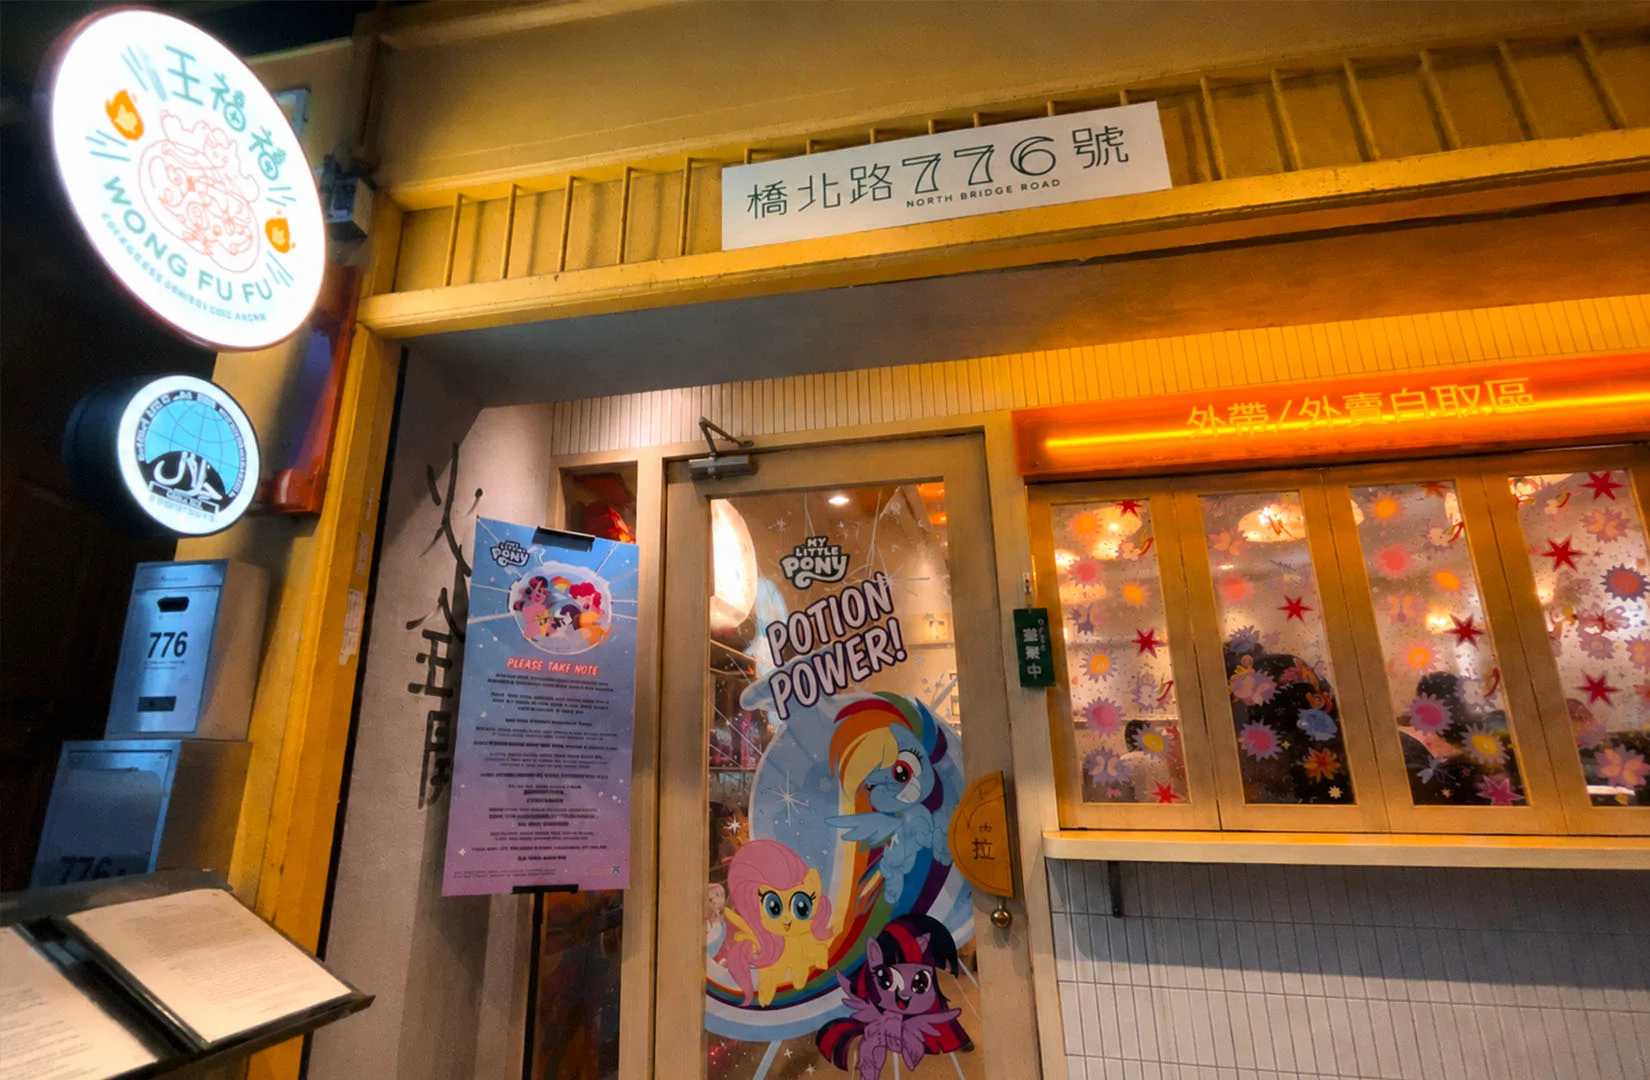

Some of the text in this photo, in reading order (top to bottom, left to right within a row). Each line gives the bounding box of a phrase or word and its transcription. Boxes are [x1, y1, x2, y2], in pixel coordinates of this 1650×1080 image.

[746, 124, 1130, 220] 橋北路776號
[905, 178, 1061, 209] NORTH BRIDGE ROAD
[103, 175, 189, 279] WONG
[198, 269, 233, 302] FU
[241, 277, 274, 304] FU
[795, 546, 840, 557] LITTLE
[806, 537, 828, 548] MY
[780, 553, 850, 589] PONY
[766, 571, 894, 668] POTION
[147, 631, 189, 659] 776
[506, 657, 599, 677] PLEASE TAKE NOTE
[769, 617, 907, 720] POWER!
